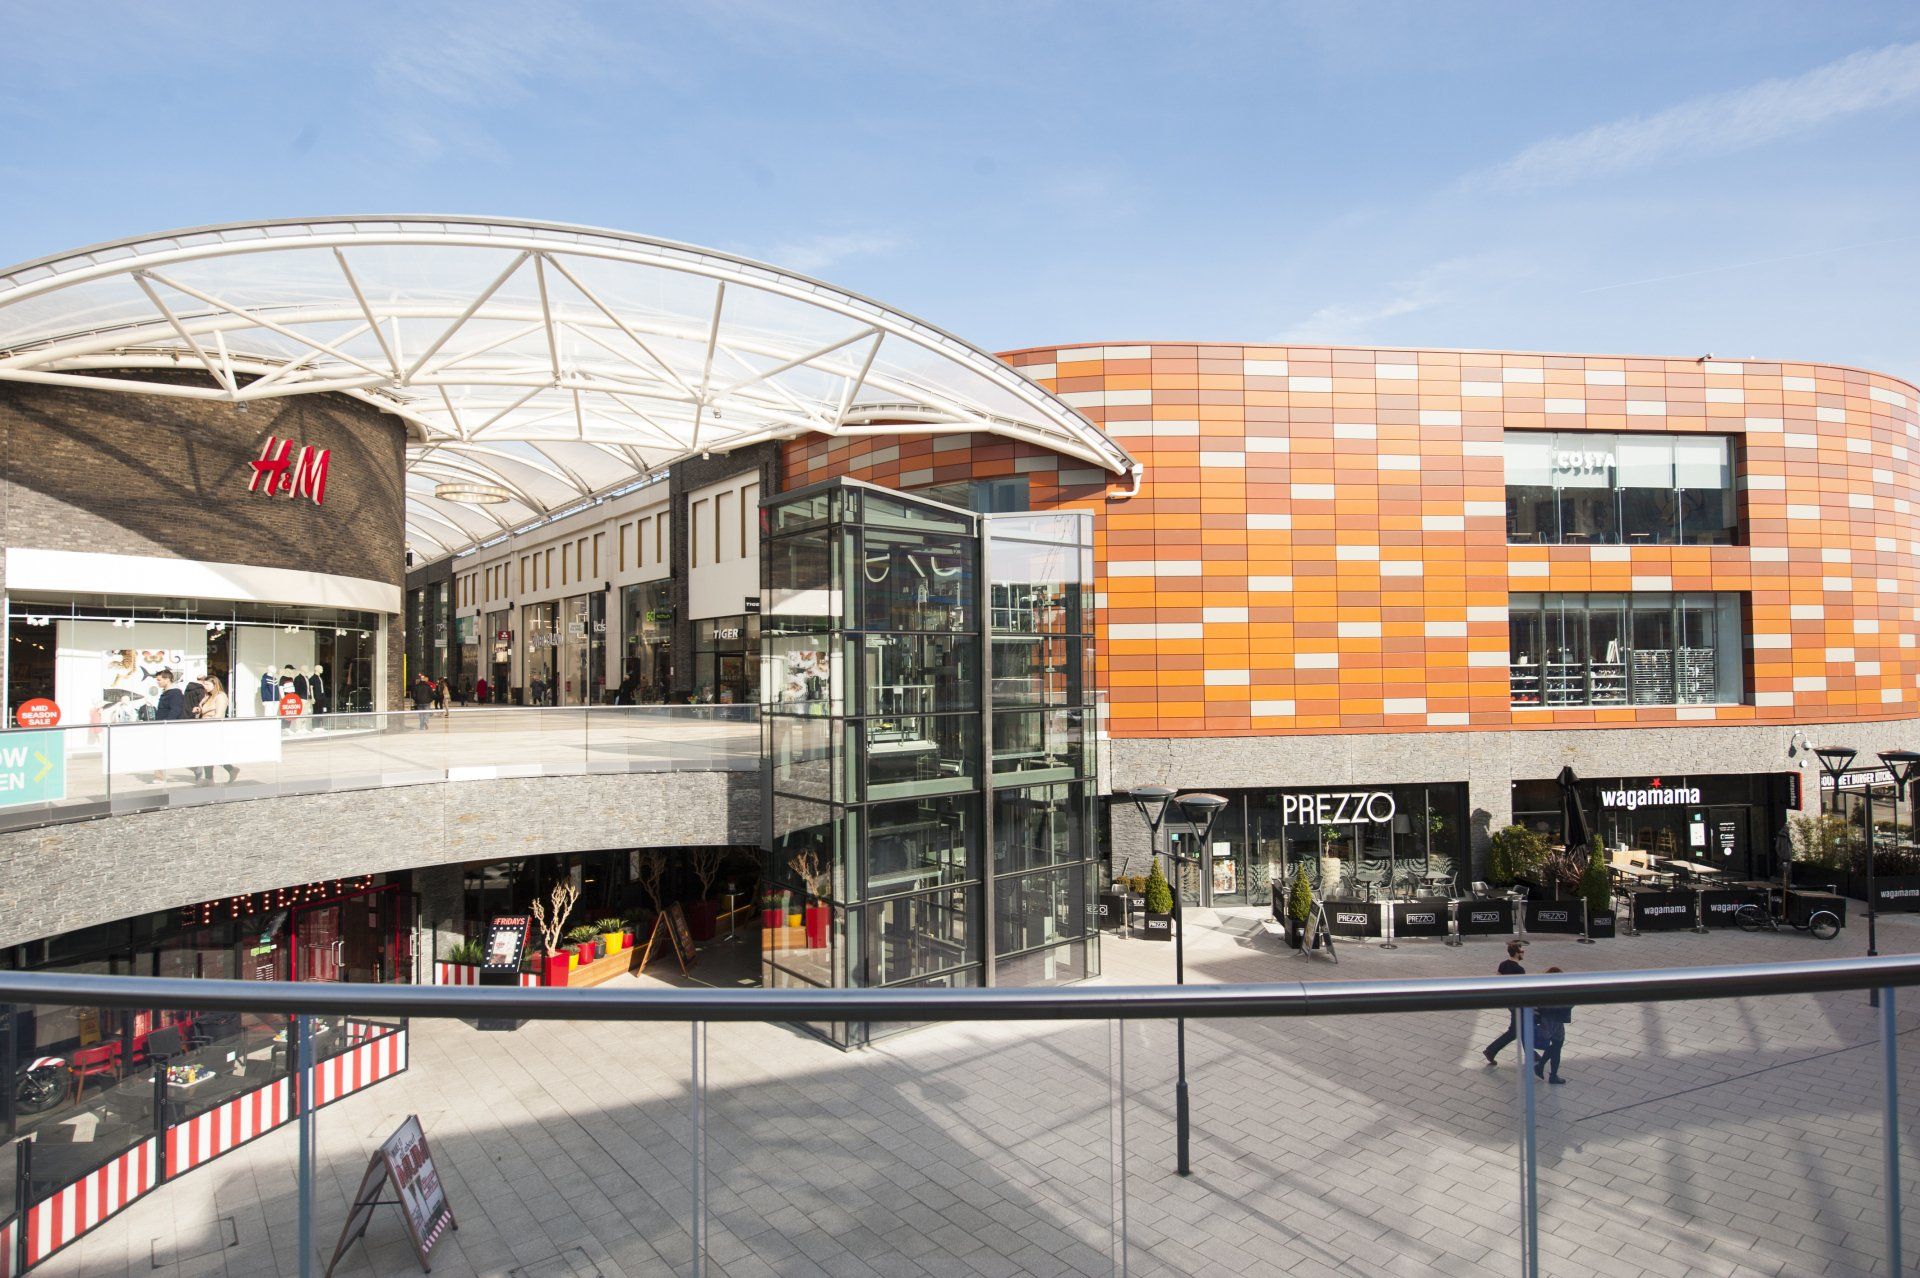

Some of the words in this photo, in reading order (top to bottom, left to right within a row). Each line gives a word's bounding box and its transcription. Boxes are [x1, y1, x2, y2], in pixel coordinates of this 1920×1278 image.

[1558, 452, 1616, 469] COSTA
[248, 436, 331, 505] H&M
[713, 628, 738, 639] TIGER
[21, 711, 57, 719] SEASON
[1601, 787, 1701, 810] wagamama
[1283, 792, 1395, 825] PREZZO
[1881, 889, 1919, 899] wagamama
[1644, 904, 1686, 916] wagamama
[1711, 903, 1745, 913] wagam
[495, 917, 525, 925] FRIDAYS
[1338, 914, 1365, 923] PREZZO
[1408, 914, 1433, 923] PREZZO
[1473, 913, 1498, 921] PREZZO
[1539, 912, 1566, 920] PREZZO
